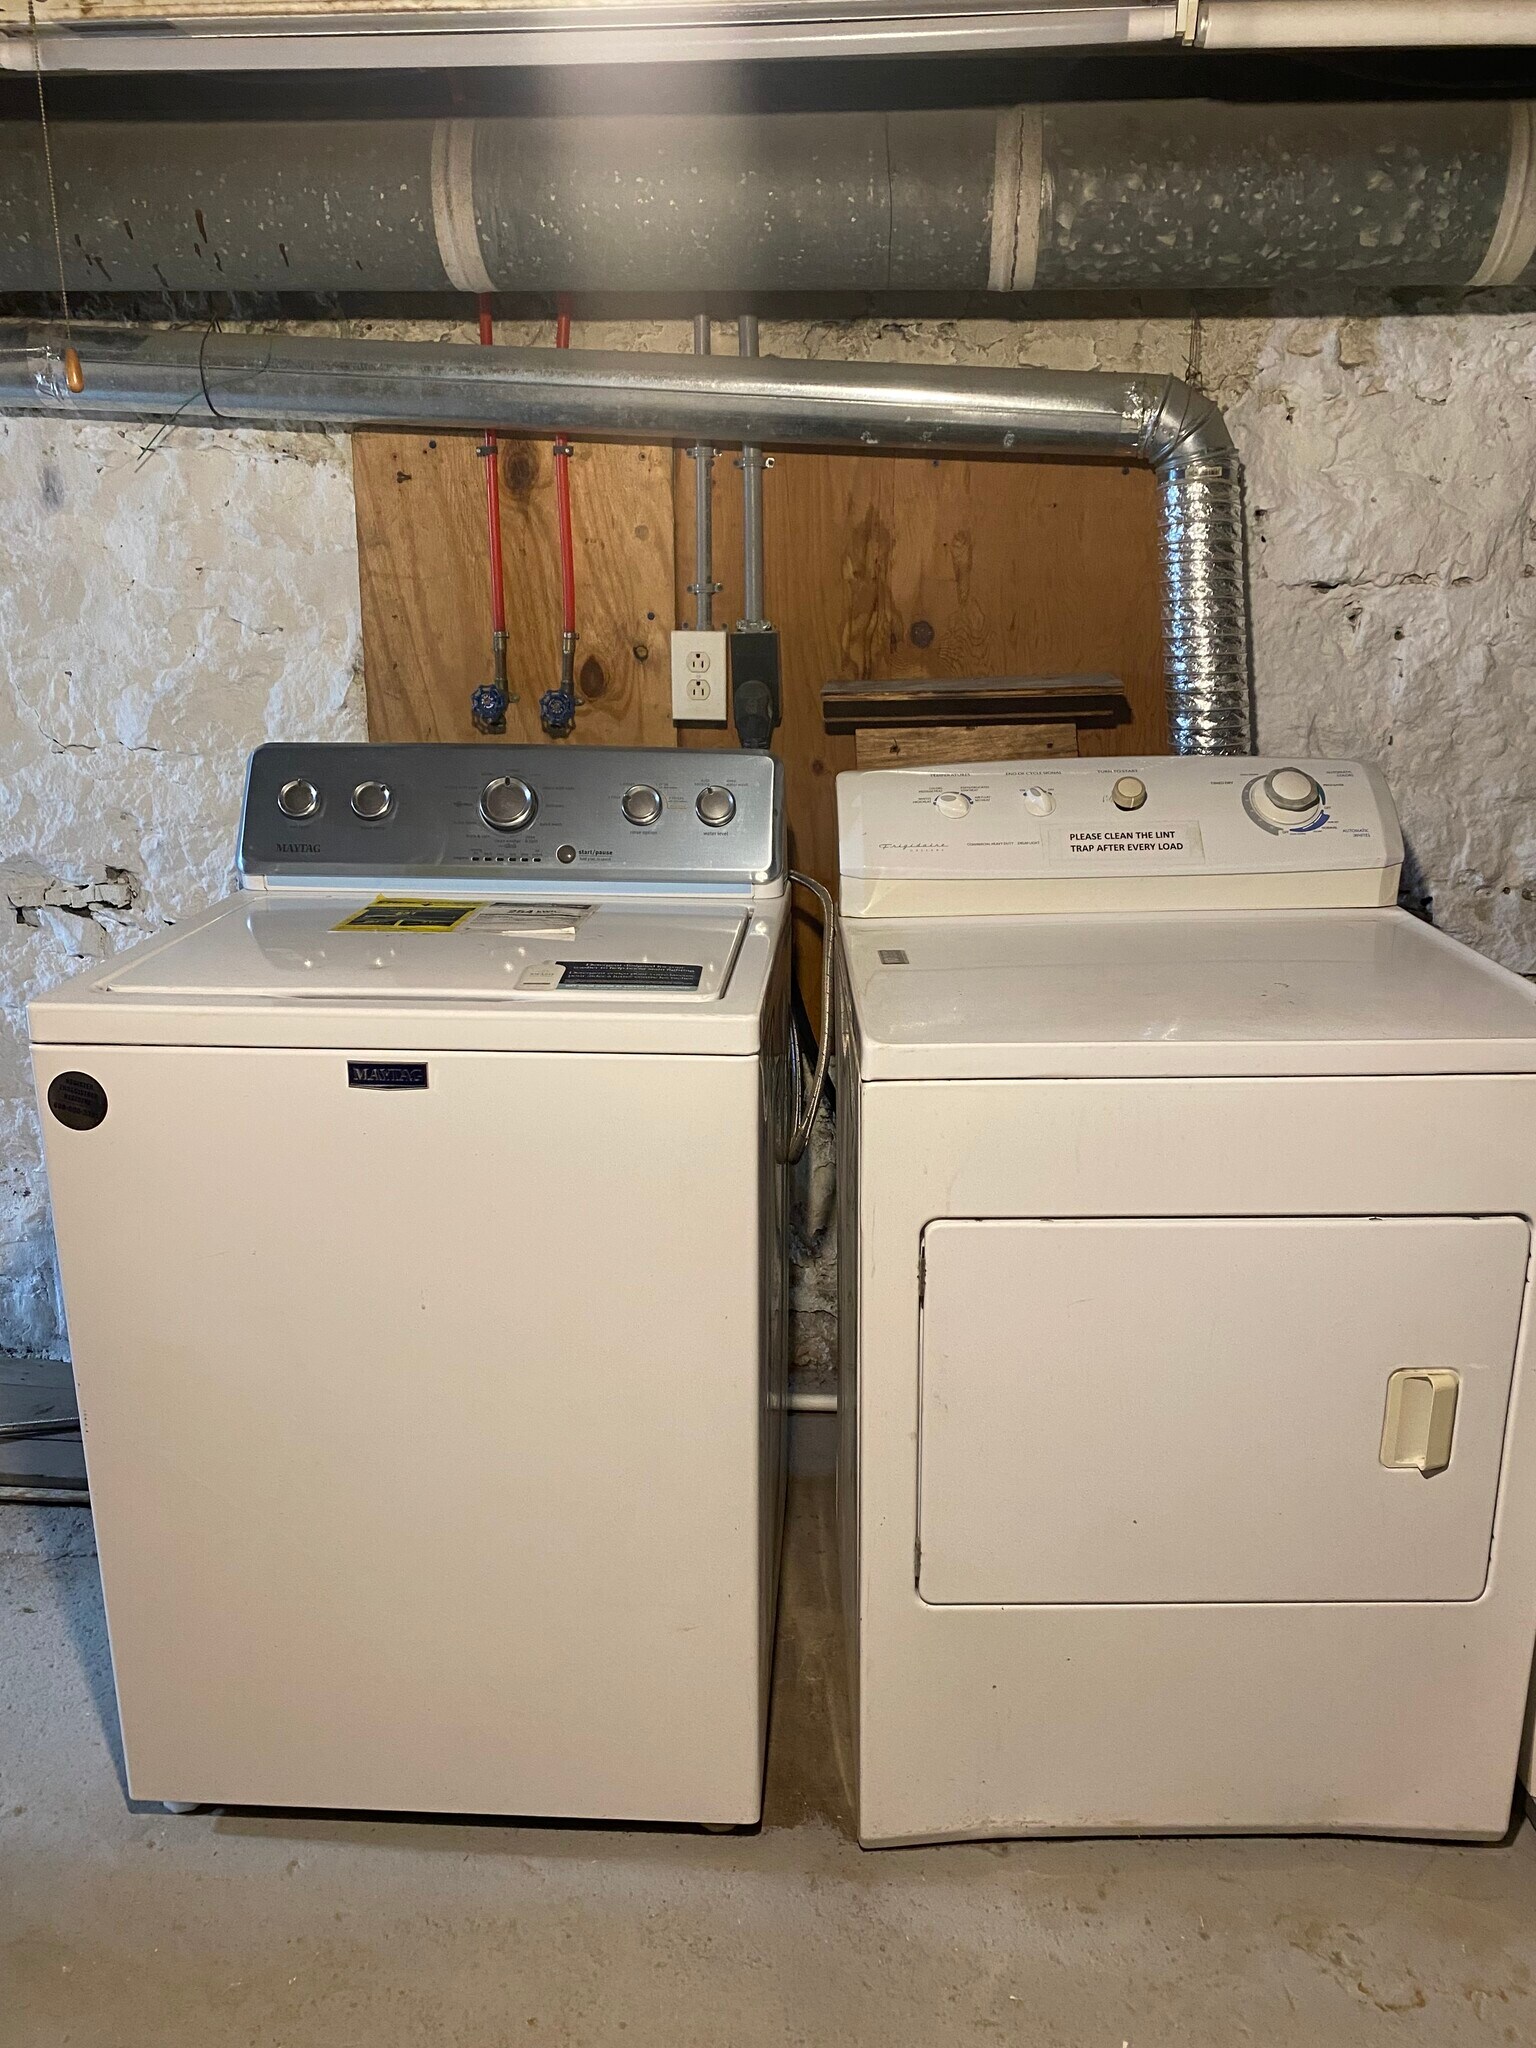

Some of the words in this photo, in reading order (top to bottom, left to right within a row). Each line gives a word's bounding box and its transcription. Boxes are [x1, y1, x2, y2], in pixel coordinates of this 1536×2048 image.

[1069, 833, 1102, 841] PLEASE
[1104, 832, 1134, 840] CLEAN
[1135, 831, 1154, 839] THE
[1155, 831, 1176, 839] LINT
[276, 843, 321, 853] MAYTAG
[1070, 844, 1095, 852] TRAP
[1096, 844, 1125, 852] AFTER
[1127, 843, 1156, 851] EVERY
[1158, 842, 1184, 850] LOAD
[353, 1068, 423, 1082] MAYTAG
